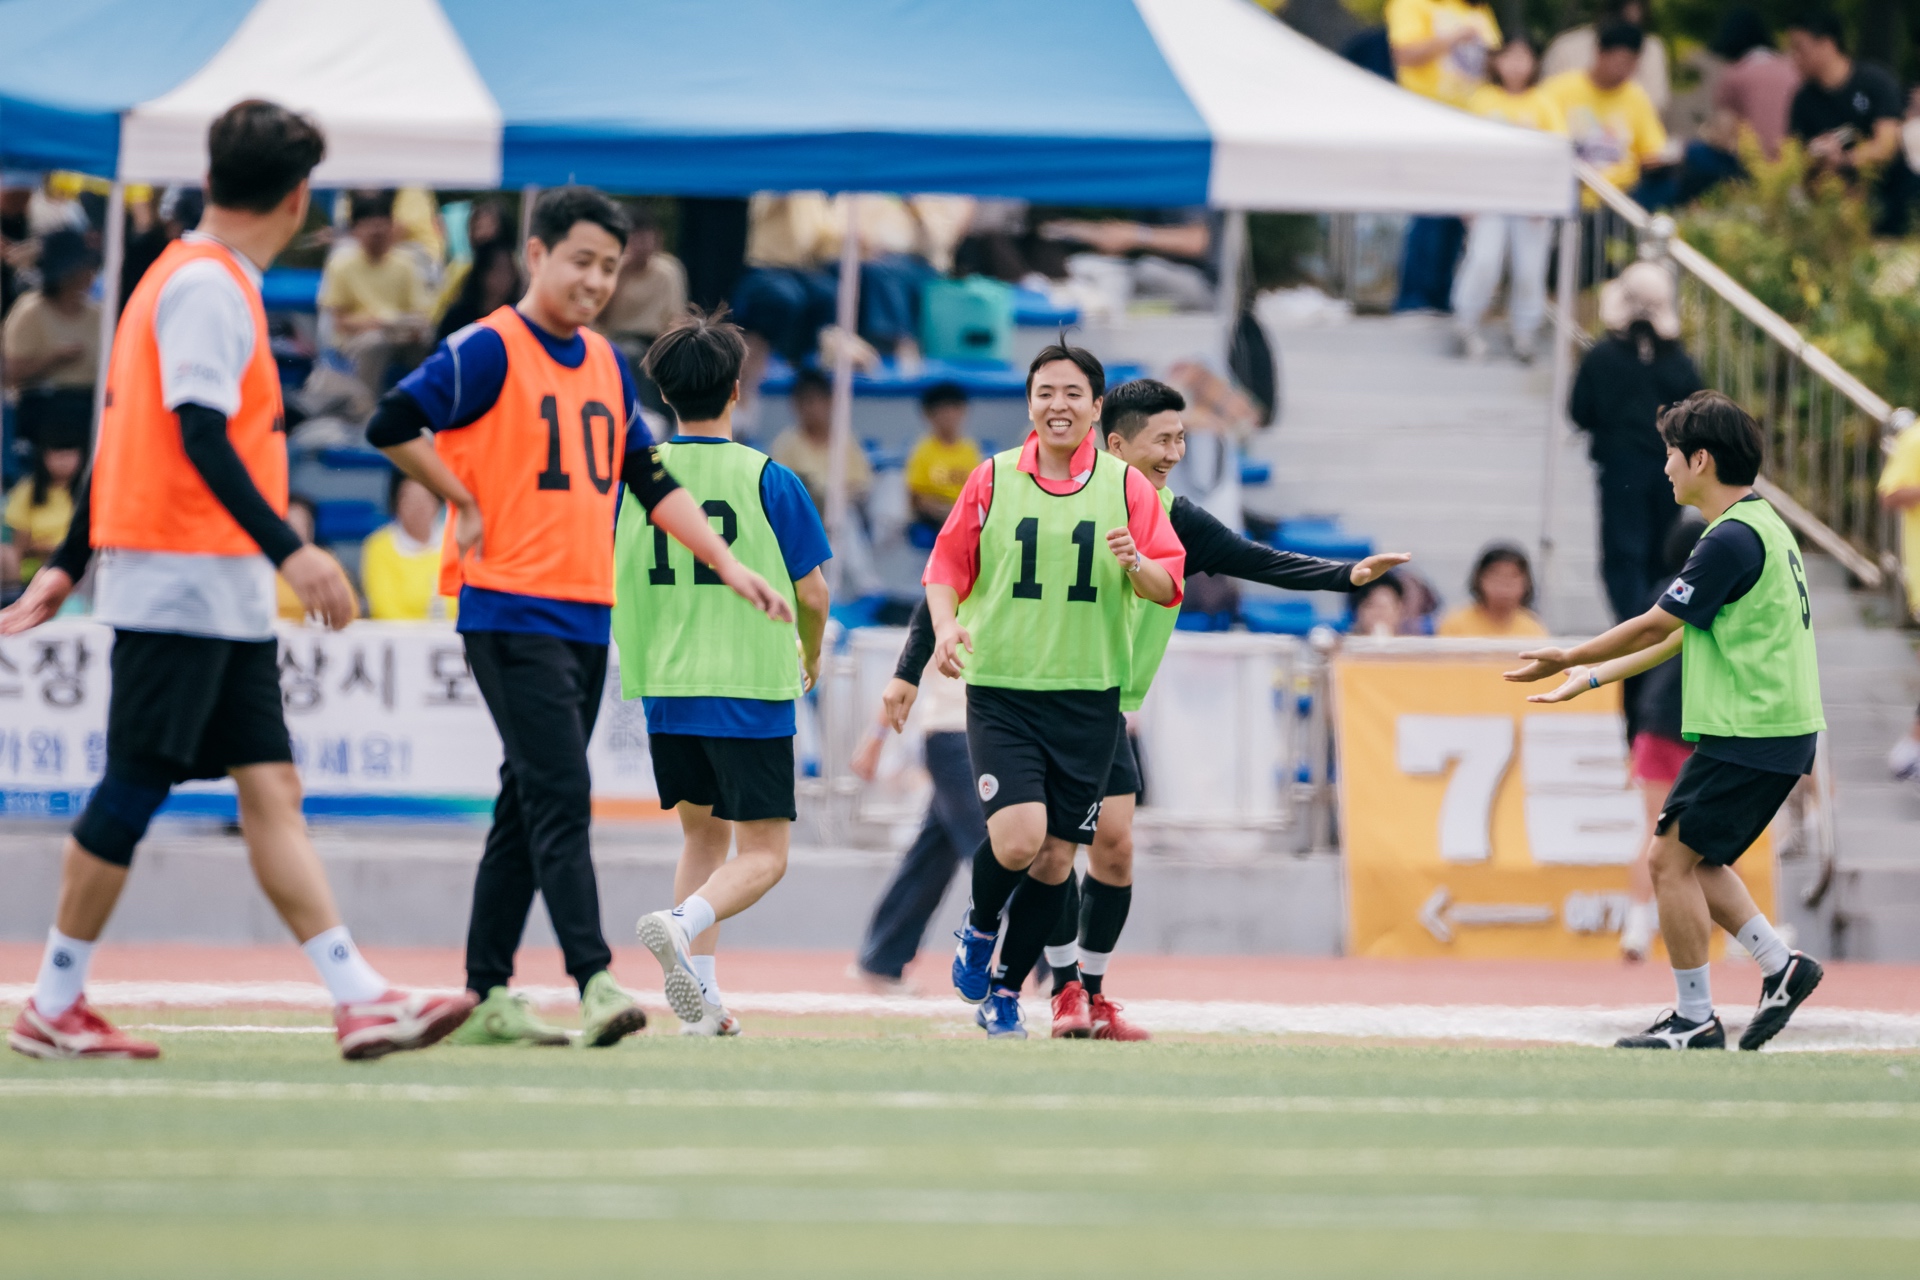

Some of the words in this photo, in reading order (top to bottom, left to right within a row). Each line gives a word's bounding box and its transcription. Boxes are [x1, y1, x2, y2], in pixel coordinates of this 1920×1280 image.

[537, 394, 615, 495] 10
[1012, 517, 1098, 602] 11
[1787, 549, 1811, 630] 6
[279, 639, 394, 714] 상시
[289, 734, 412, 779] 세요!
